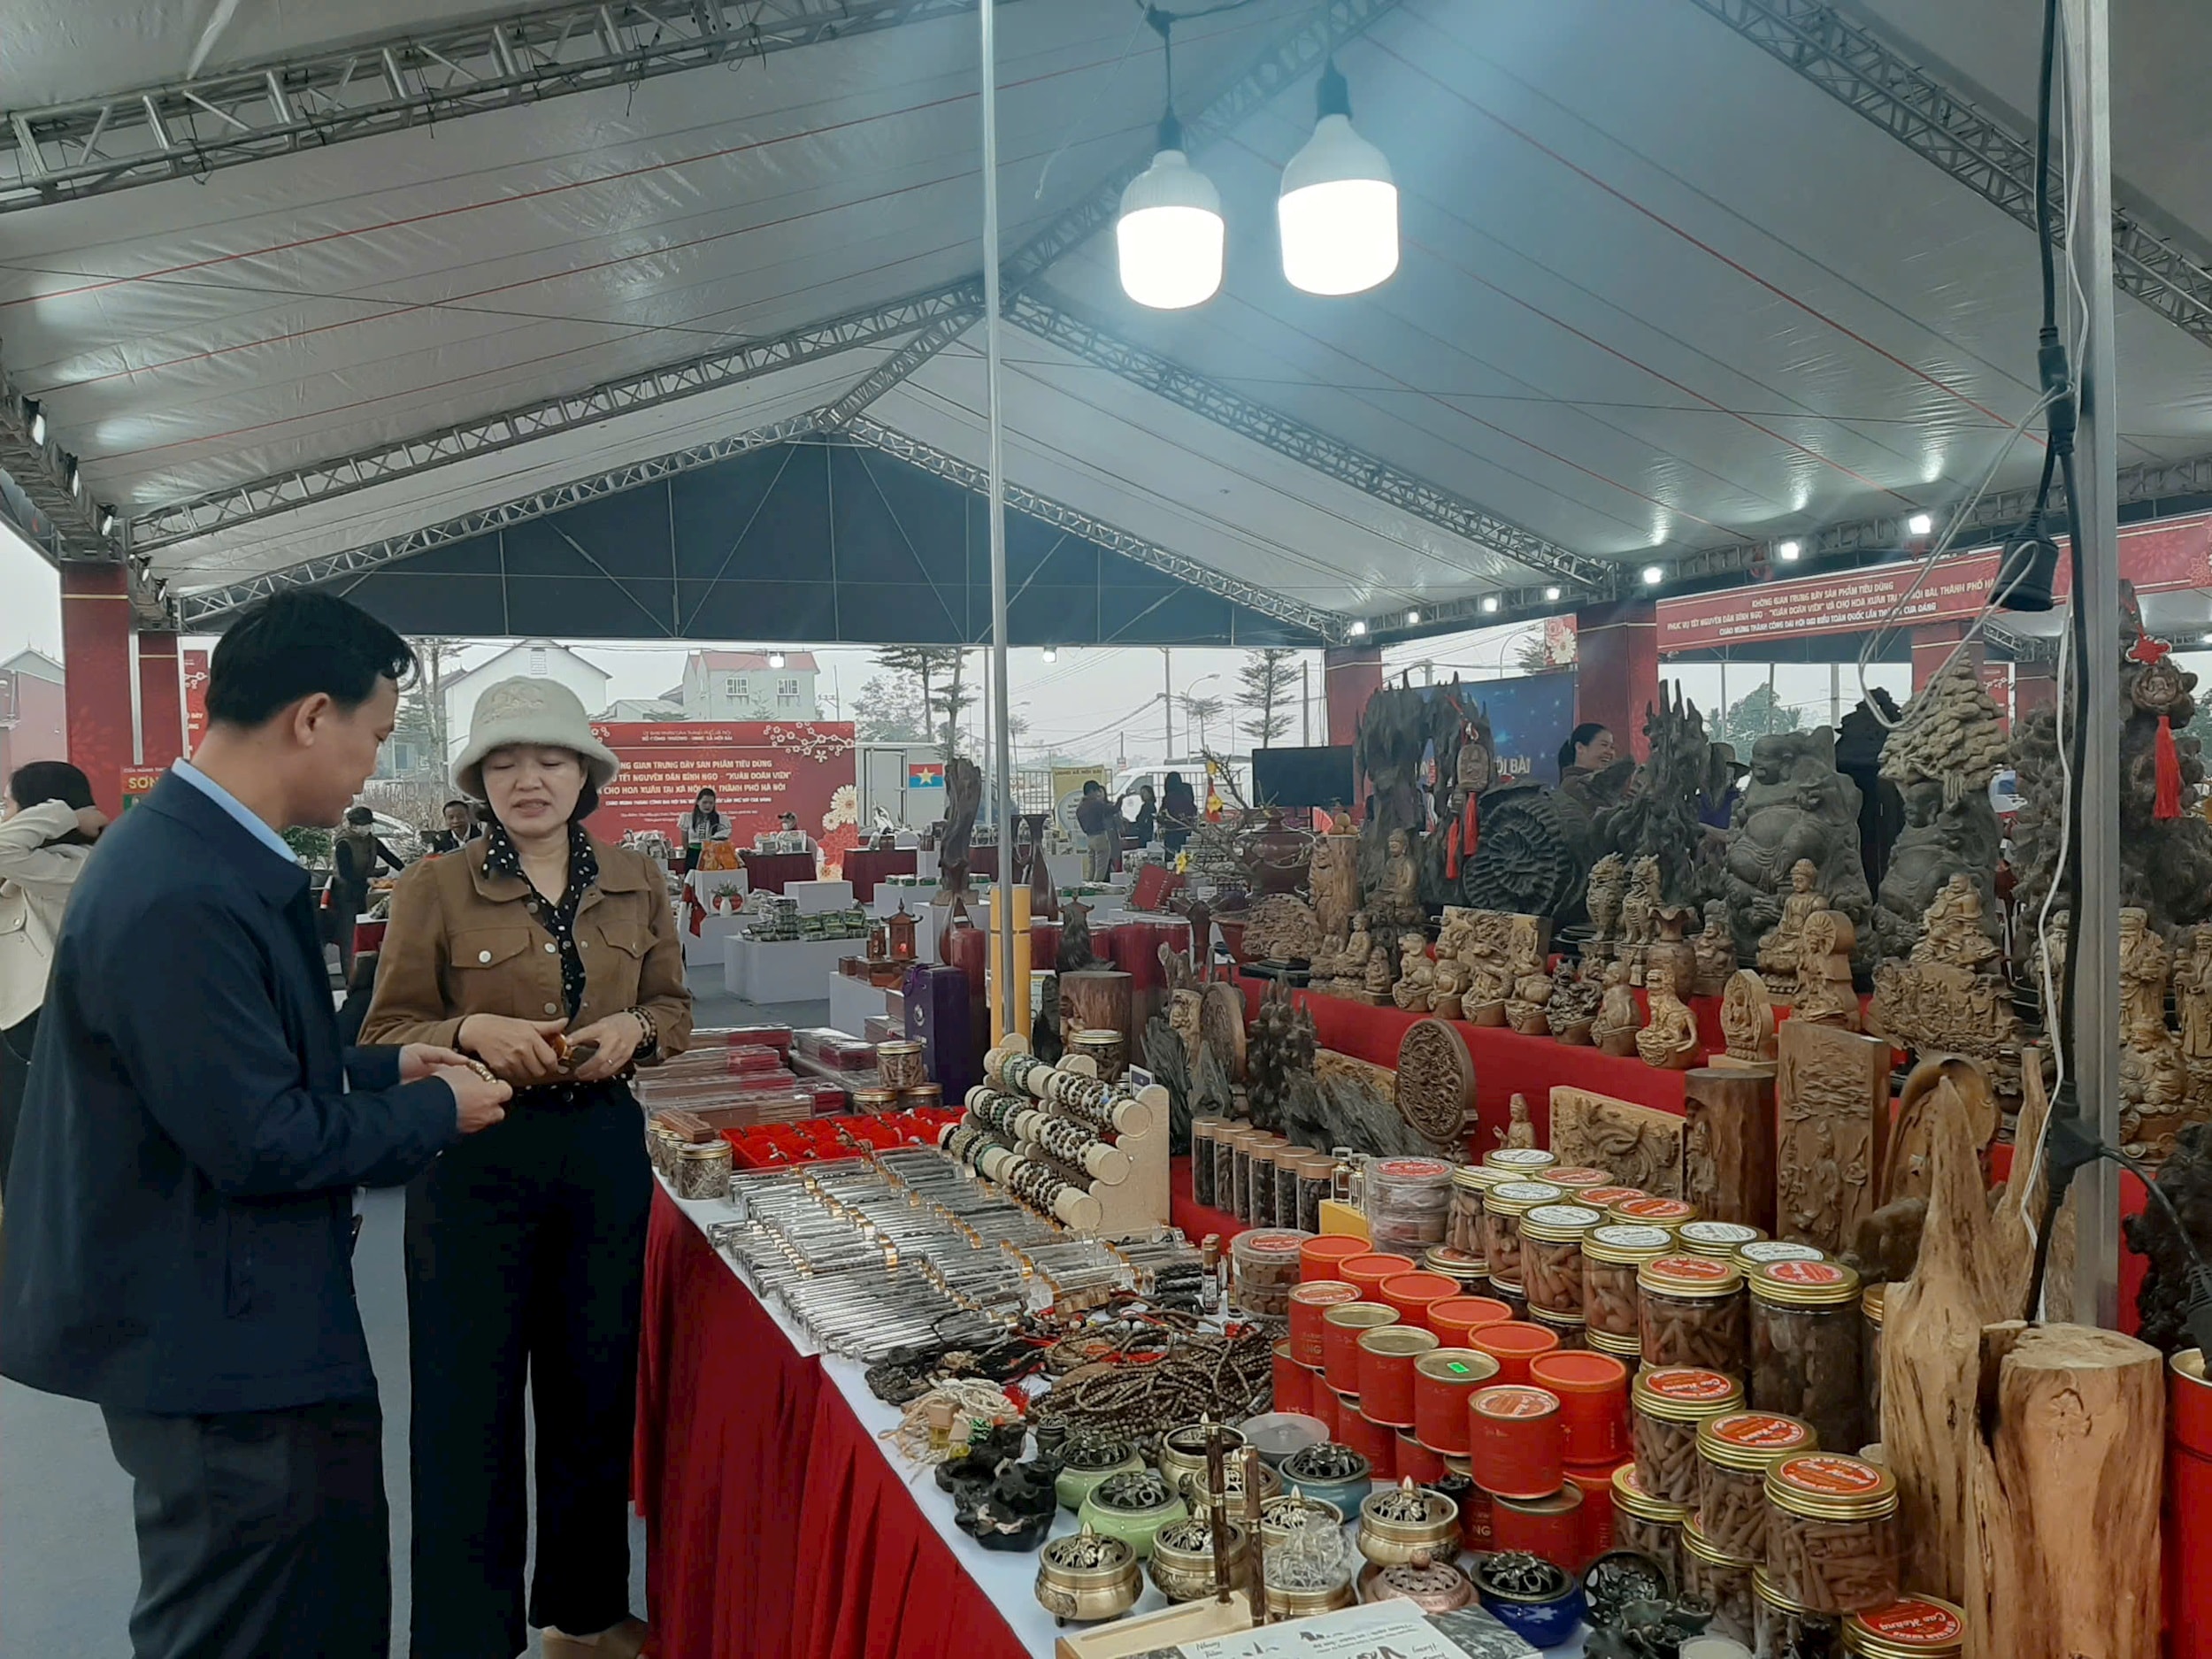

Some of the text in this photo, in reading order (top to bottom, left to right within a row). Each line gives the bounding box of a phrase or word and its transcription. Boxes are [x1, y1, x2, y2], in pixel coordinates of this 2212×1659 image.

[1774, 595, 1788, 605] GIAN
[1874, 581, 1893, 592] DÙNG
[735, 759, 750, 768] TIÊU
[633, 772, 664, 781] NGUYÊN
[640, 785, 661, 794] XUÂN
[744, 783, 760, 792] PHỐ
[761, 783, 772, 792] HÀ
[1922, 1611, 1947, 1623] Cao
